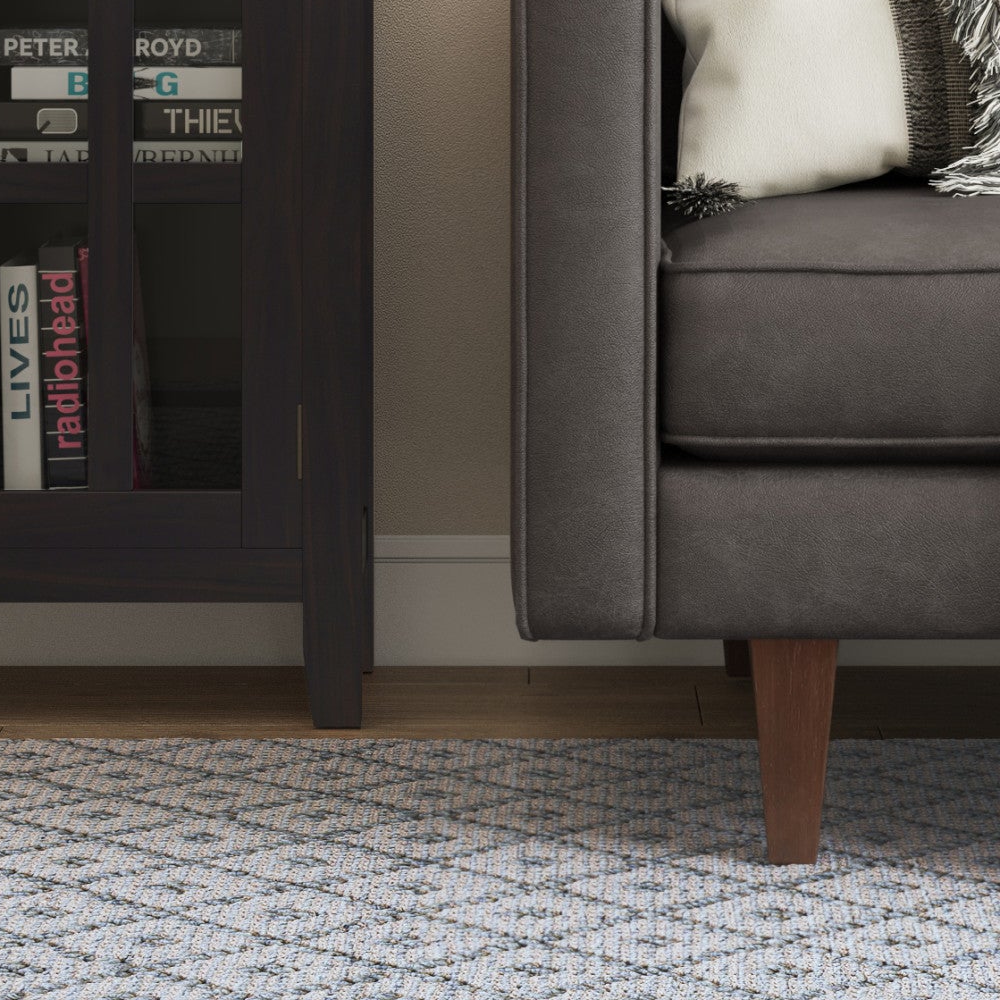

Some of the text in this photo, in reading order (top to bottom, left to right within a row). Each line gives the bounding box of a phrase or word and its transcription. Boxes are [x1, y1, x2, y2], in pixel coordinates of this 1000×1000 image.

[3, 37, 78, 57] PETER
[8, 283, 32, 420] LIVES
[42, 272, 83, 449] radiohead
